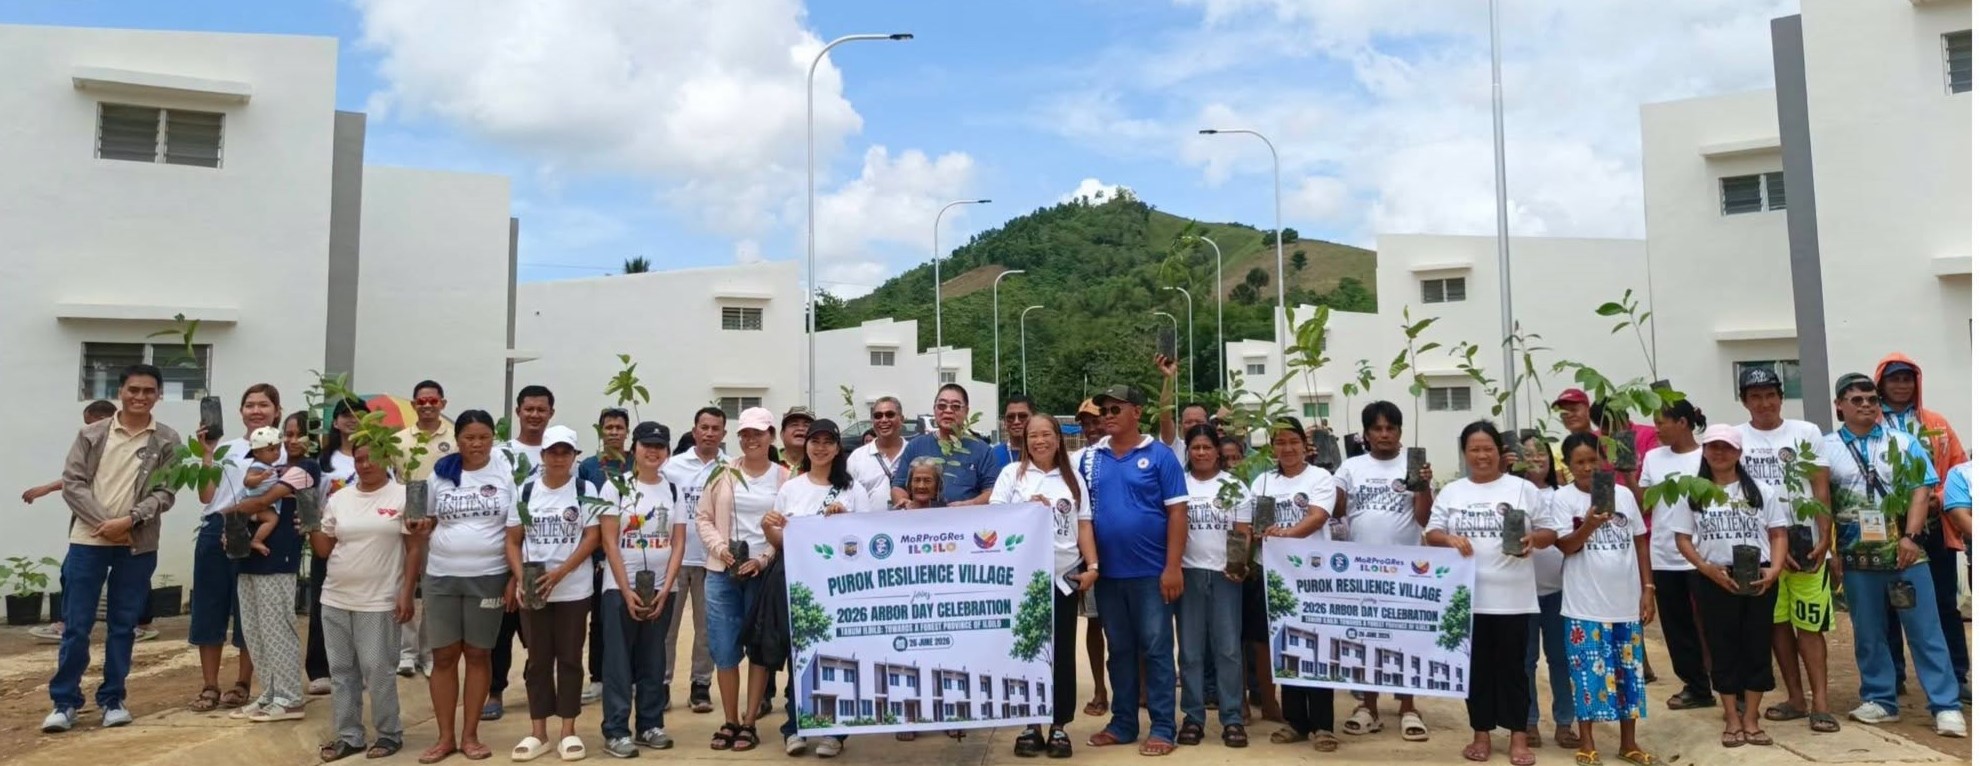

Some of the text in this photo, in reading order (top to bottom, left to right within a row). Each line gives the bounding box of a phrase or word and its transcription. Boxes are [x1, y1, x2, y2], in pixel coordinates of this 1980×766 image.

[1745, 456, 1779, 465] Purok
[1360, 485, 1391, 493] Purok
[684, 493, 701, 501] Pur
[1187, 502, 1211, 511] urok
[532, 514, 562, 523] urok
[1455, 517, 1503, 531] RESILIEN
[900, 532, 965, 543] MoRProGRes
[908, 542, 956, 554] ILOILO
[1360, 564, 1398, 573] ILOILO
[827, 564, 1014, 596] PUROK RESILIENCE VILLAGE
[1296, 578, 1442, 602] PUROK RESILIENCE VILLAGE
[837, 599, 1011, 623] 2026 ARBOR DAY CELEBRATION
[1303, 601, 1438, 622] 2026 ARBOR DAY CELEBRATION
[1796, 600, 1821, 624] 05
[919, 637, 933, 646] JUNE
[935, 636, 951, 646] 2026
